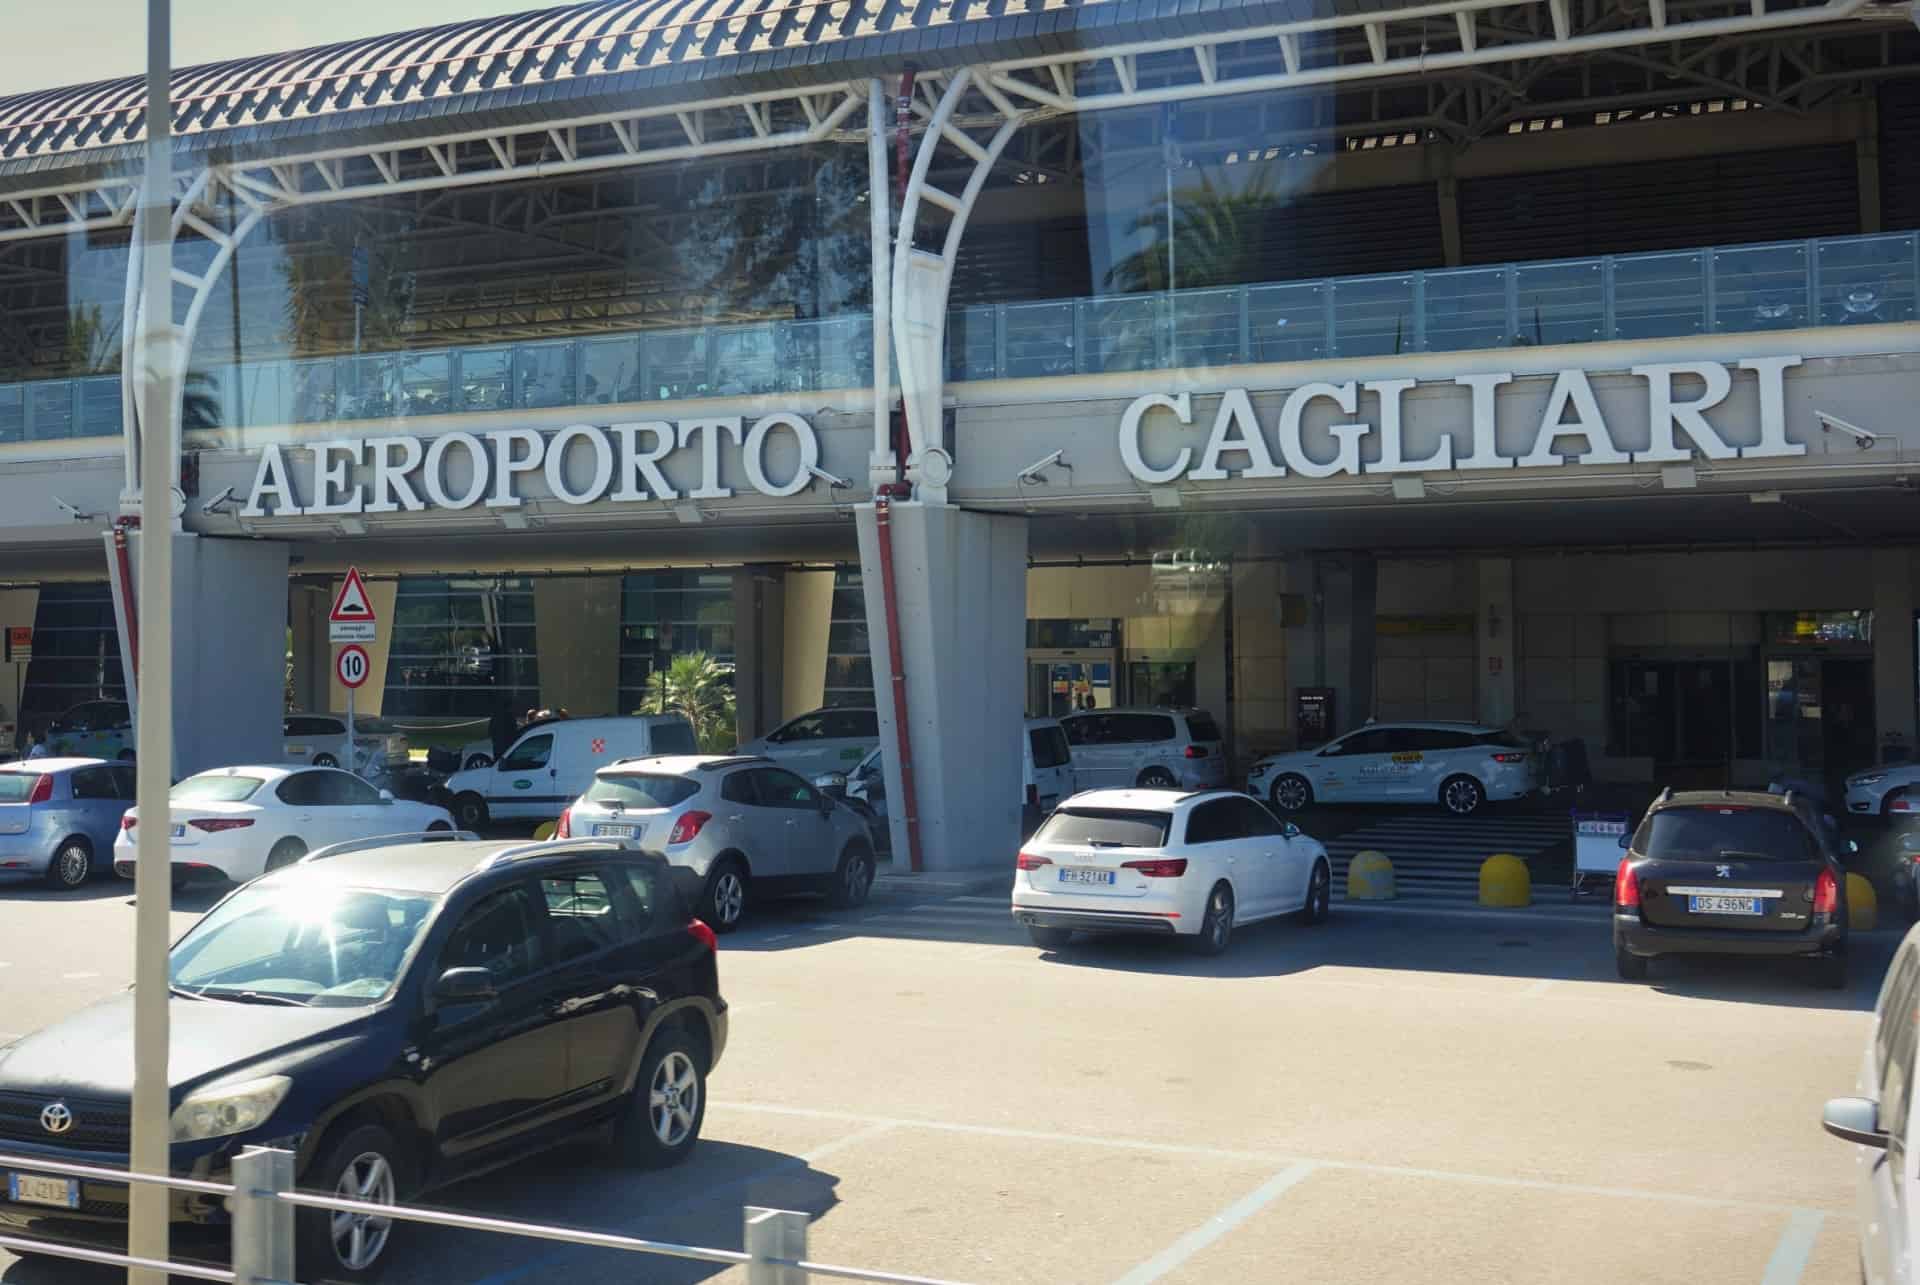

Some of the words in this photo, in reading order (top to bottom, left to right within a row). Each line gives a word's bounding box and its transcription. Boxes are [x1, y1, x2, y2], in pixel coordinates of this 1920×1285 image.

[239, 411, 819, 518] AEROPORTO
[1119, 354, 1807, 484] CAGLIARI
[345, 655, 362, 677] 10
